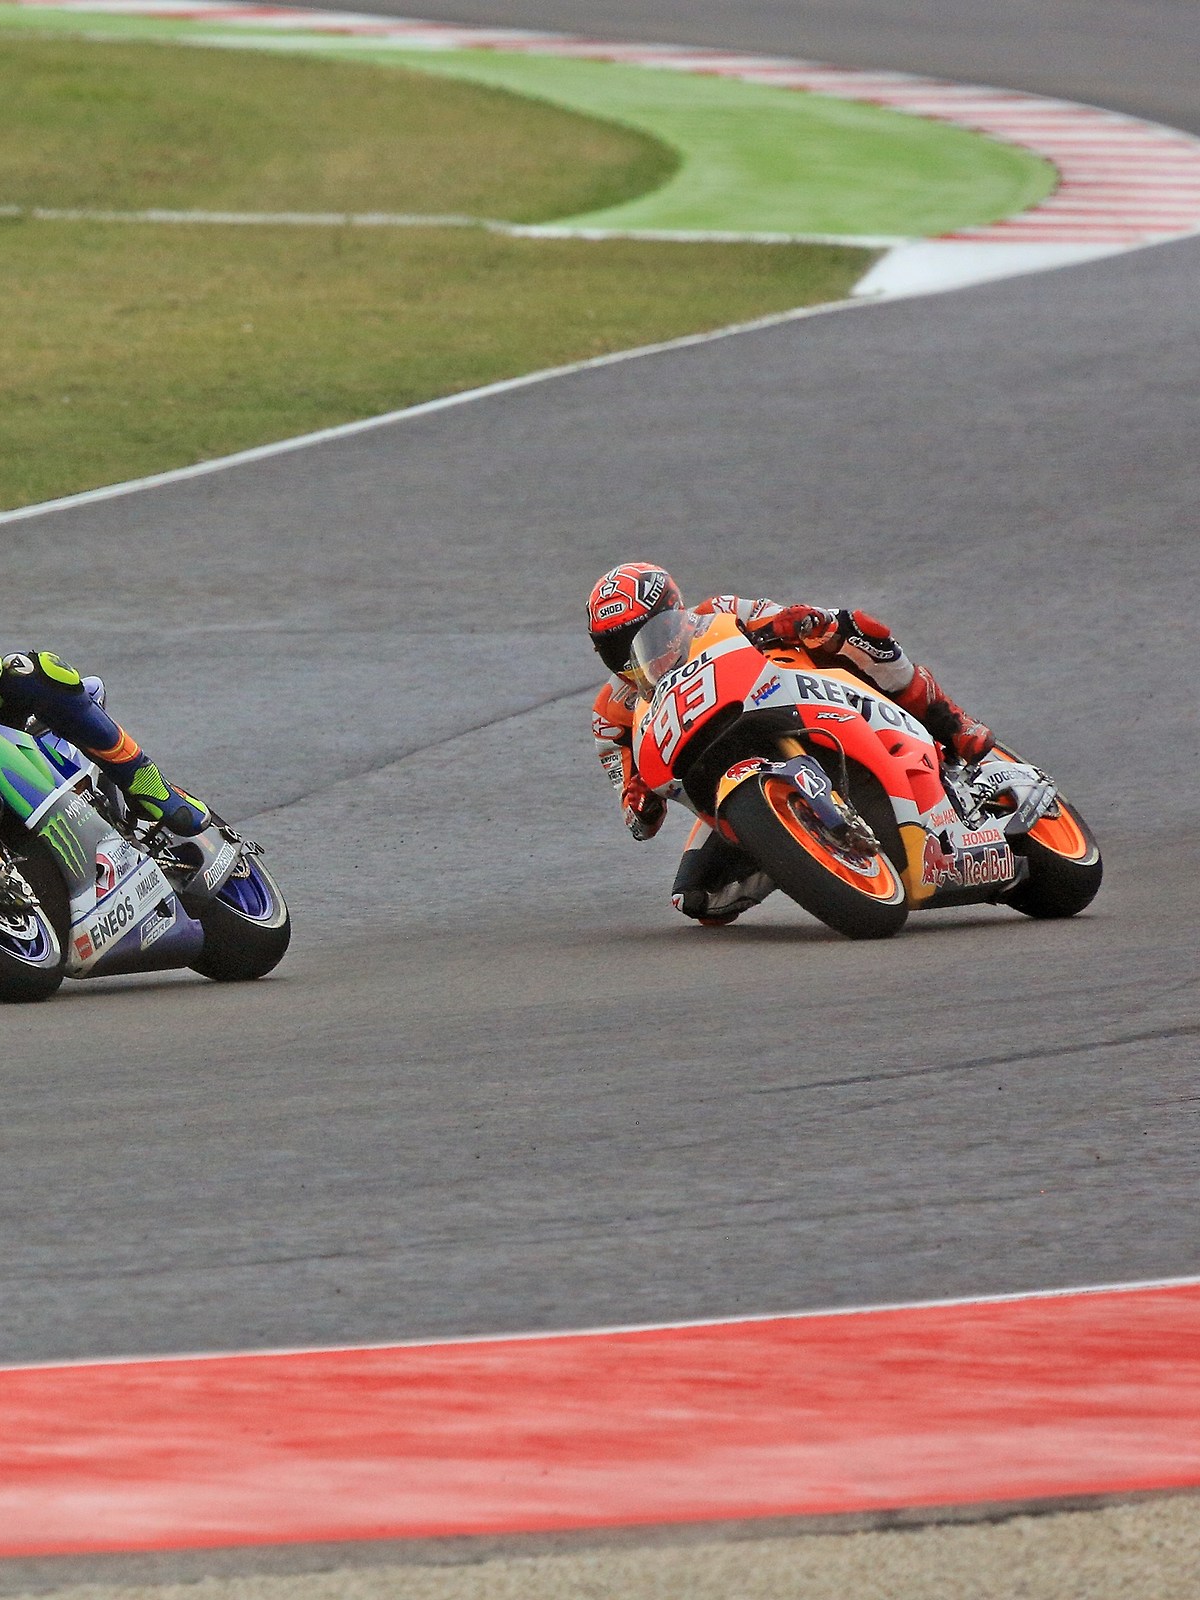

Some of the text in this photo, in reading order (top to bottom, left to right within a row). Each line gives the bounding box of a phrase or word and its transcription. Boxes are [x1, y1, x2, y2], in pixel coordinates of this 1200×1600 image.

[600, 603, 623, 618] SHOEI
[653, 662, 718, 766] 93
[962, 828, 1002, 847] HONDA
[90, 896, 135, 950] ENEOS
